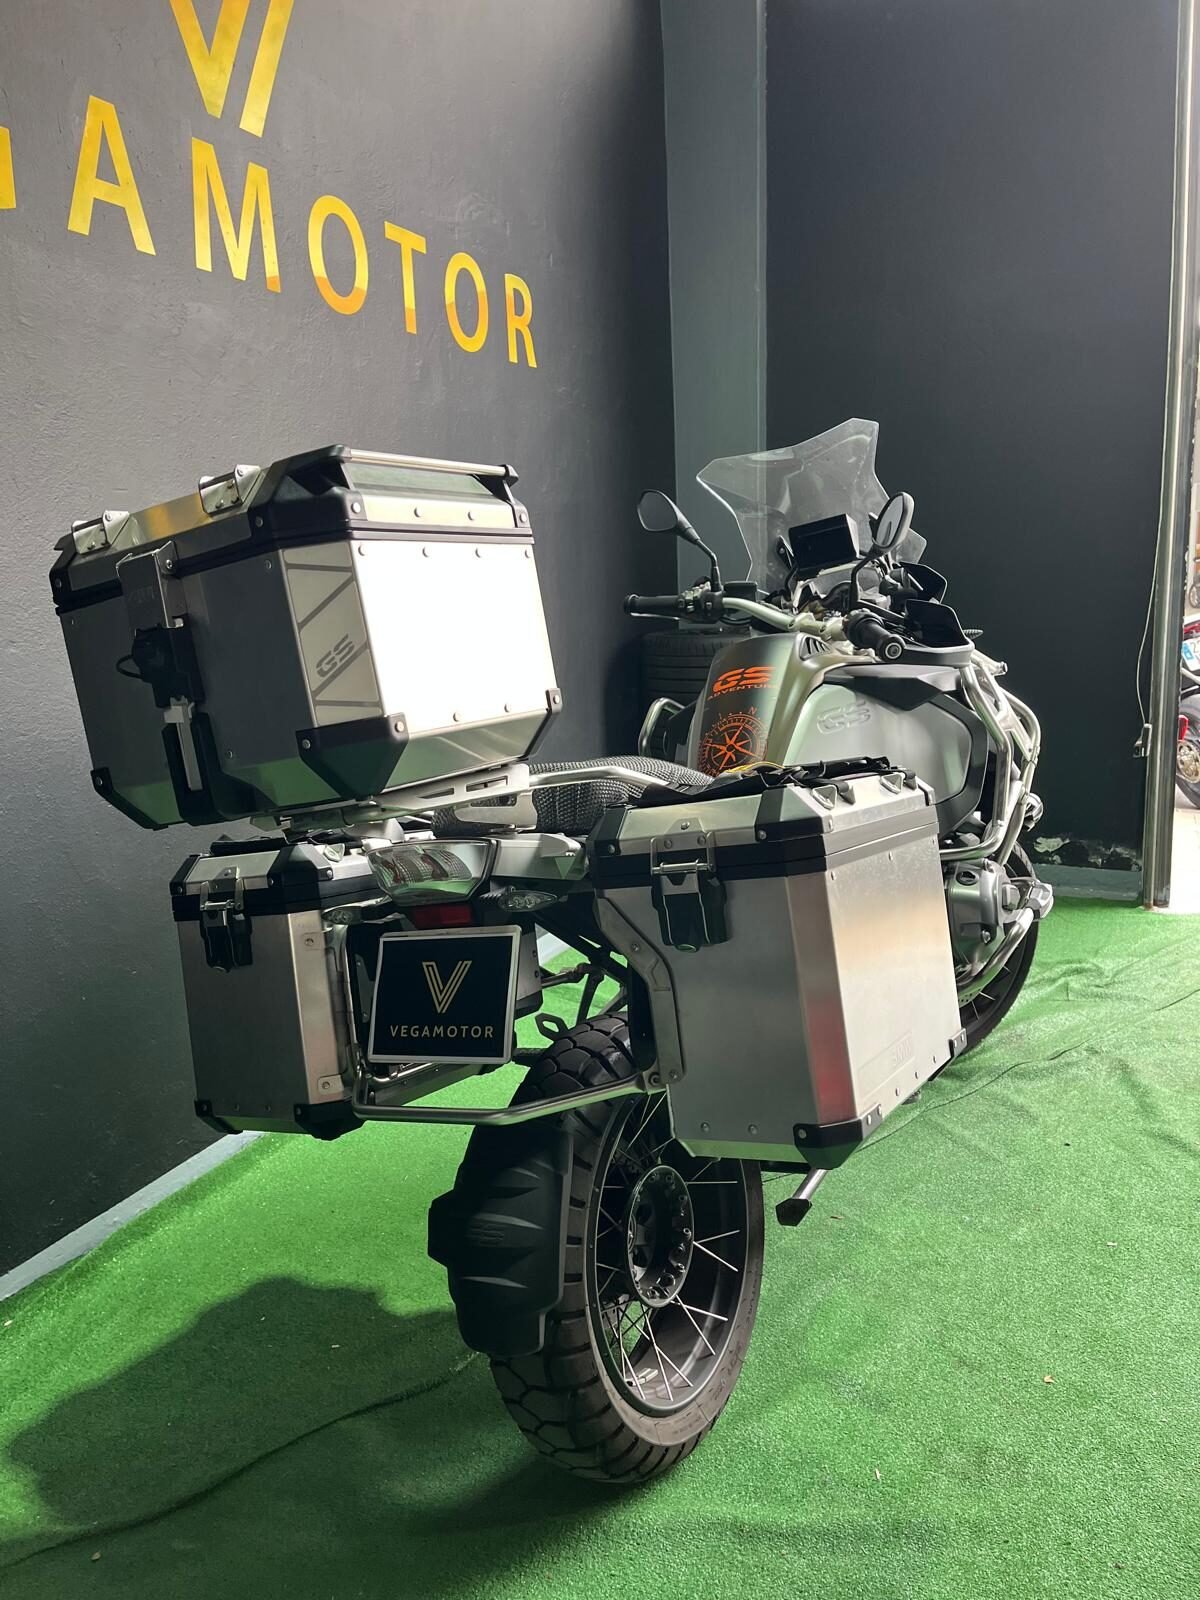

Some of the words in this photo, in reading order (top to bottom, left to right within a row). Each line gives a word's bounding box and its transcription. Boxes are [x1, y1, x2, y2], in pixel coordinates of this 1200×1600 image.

[316, 633, 355, 678] GS
[713, 666, 776, 692] GS
[816, 702, 871, 735] GS
[390, 1025, 494, 1038] VEGAMOTOR
